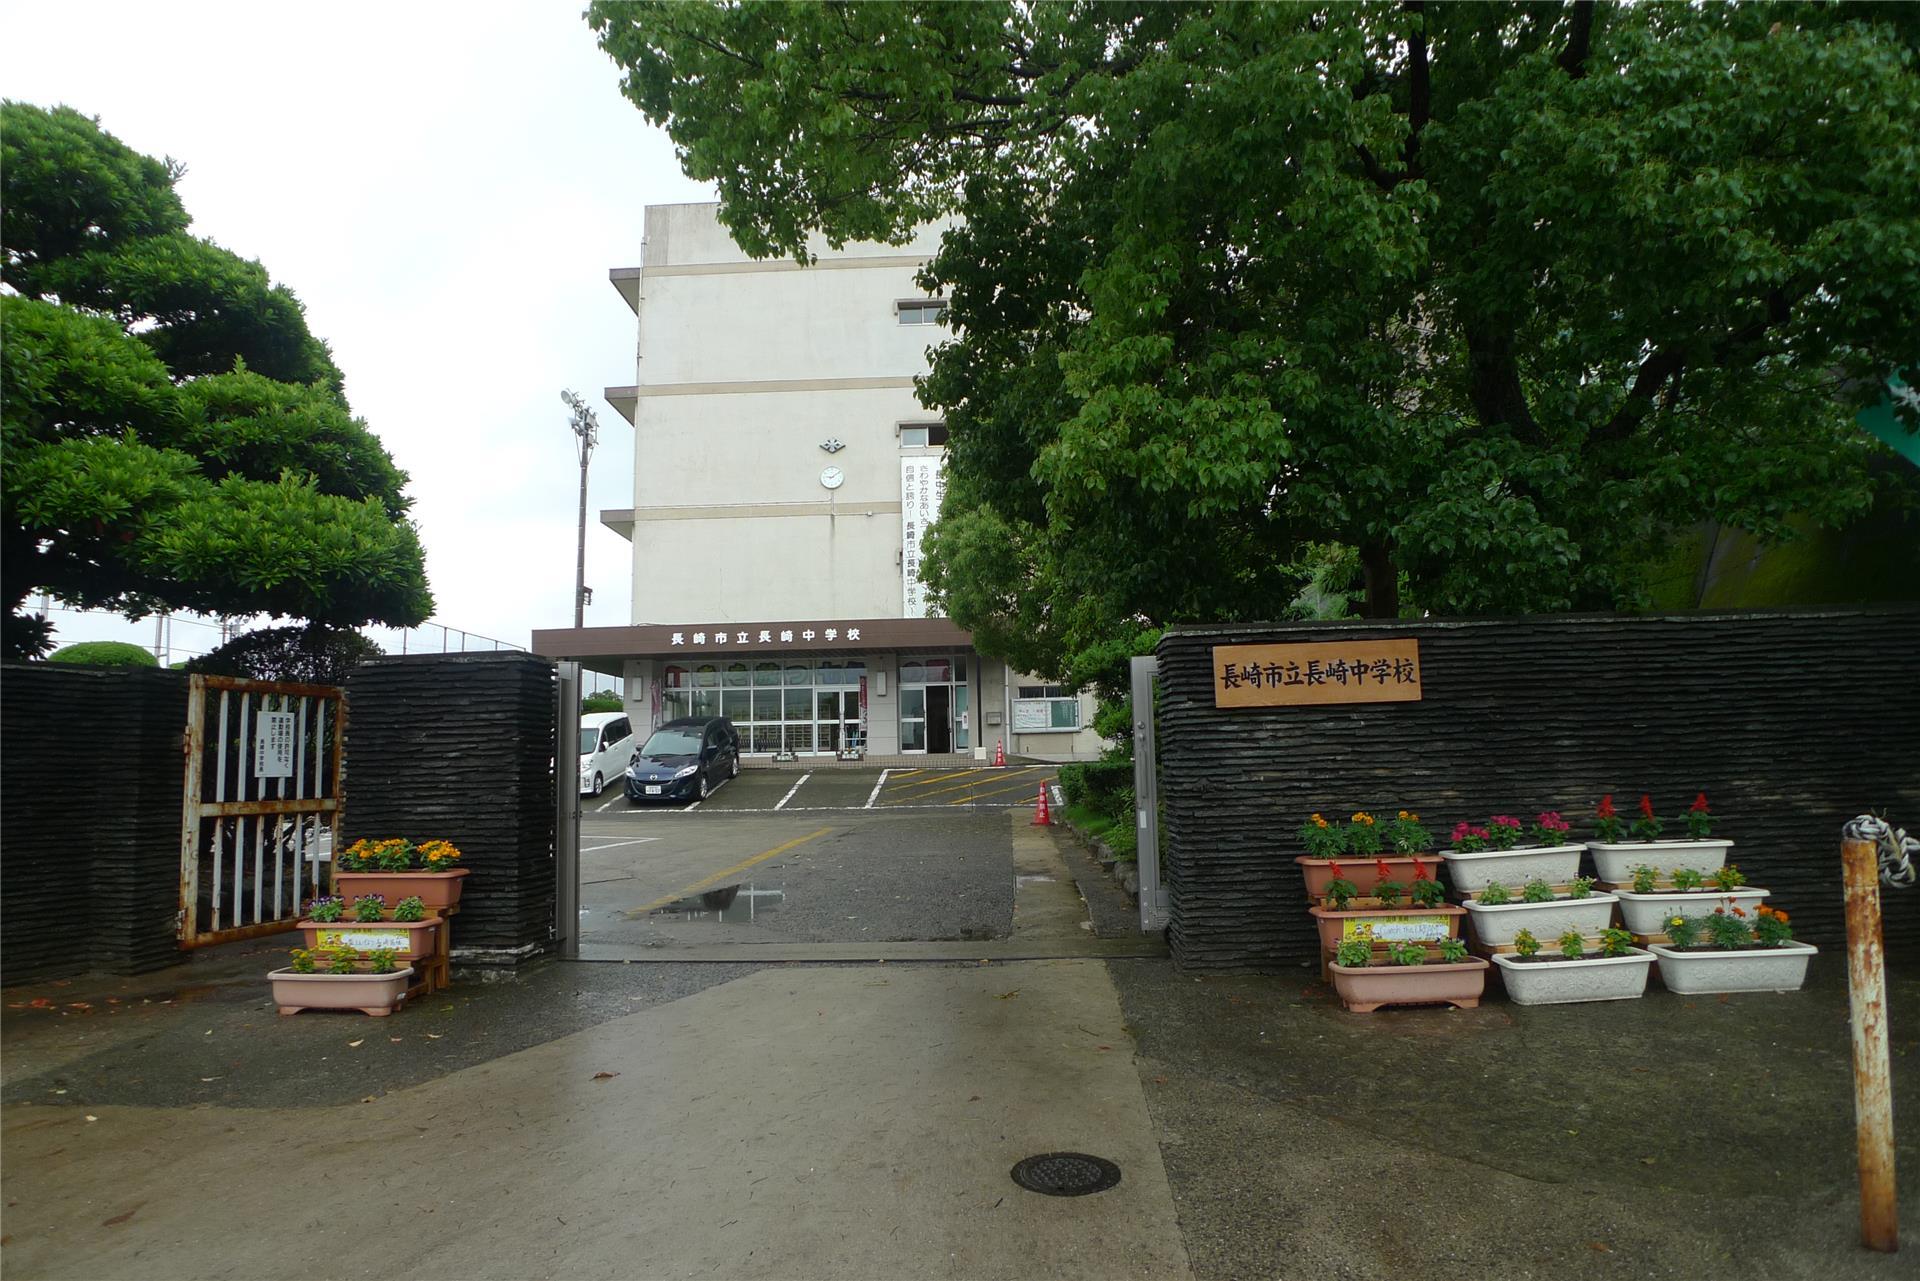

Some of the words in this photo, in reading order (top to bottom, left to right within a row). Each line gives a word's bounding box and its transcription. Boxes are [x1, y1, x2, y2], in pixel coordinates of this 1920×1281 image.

[919, 464, 929, 528] さわやかなあいさ
[671, 628, 861, 646] 長崎市立長崎中学校
[1220, 657, 1416, 690] 長崎市立長崎中学校
